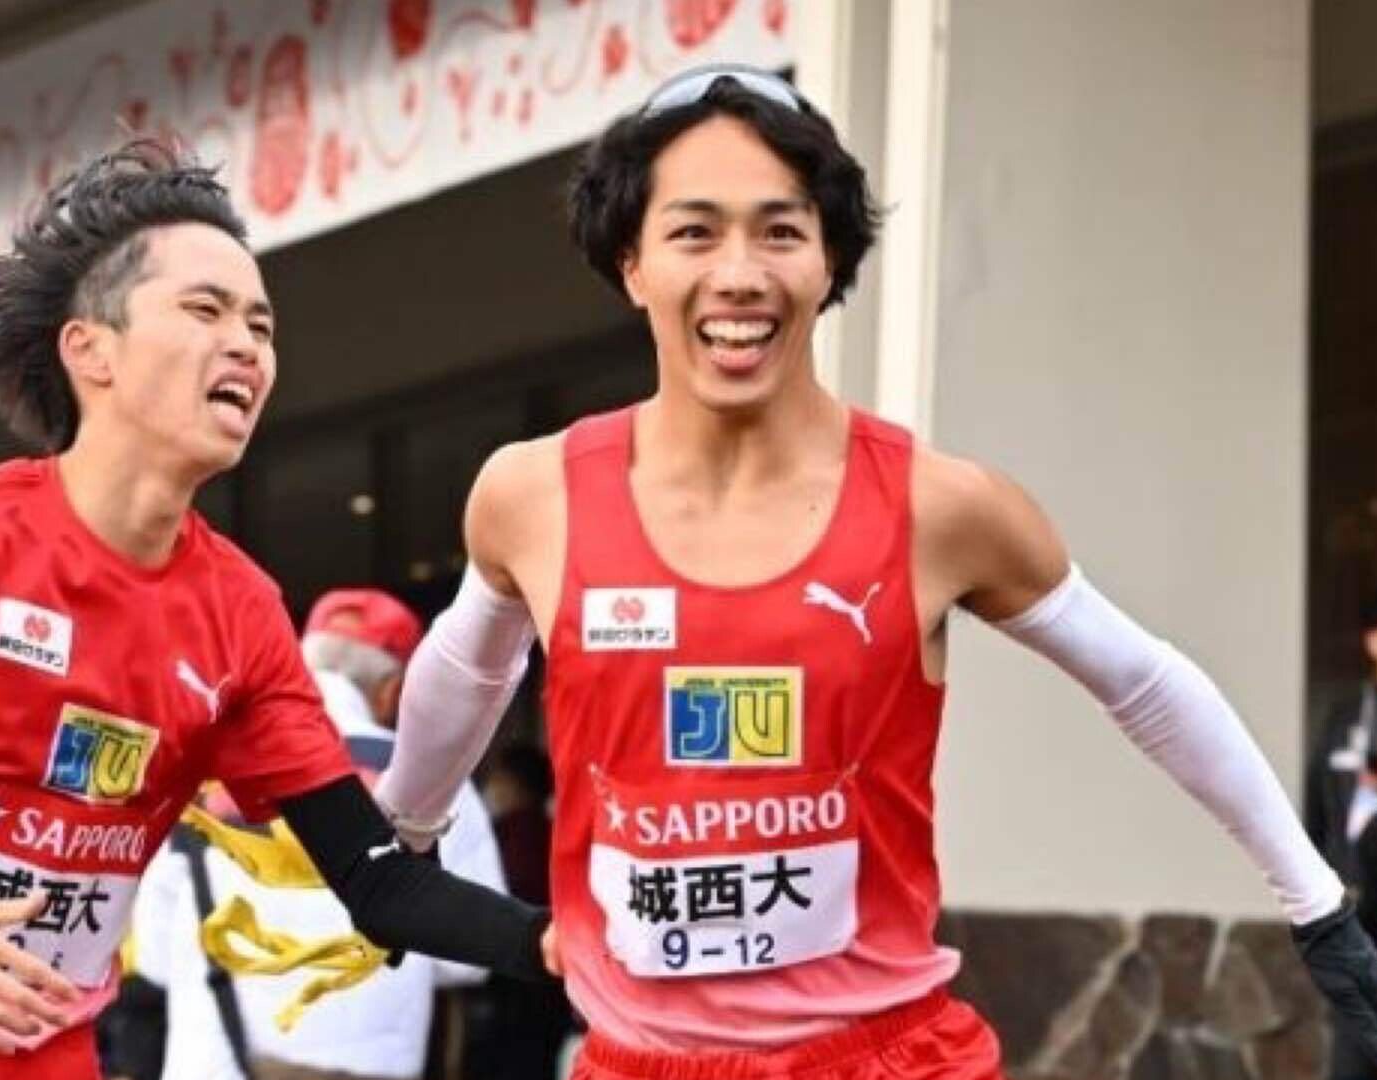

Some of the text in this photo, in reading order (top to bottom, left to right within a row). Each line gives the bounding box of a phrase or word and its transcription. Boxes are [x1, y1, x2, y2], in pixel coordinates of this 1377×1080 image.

[680, 687, 791, 758] JU
[54, 727, 142, 798] JU
[10, 806, 147, 864] SAPPORO
[634, 790, 847, 845] SAPPORO
[627, 855, 813, 925] 城西大
